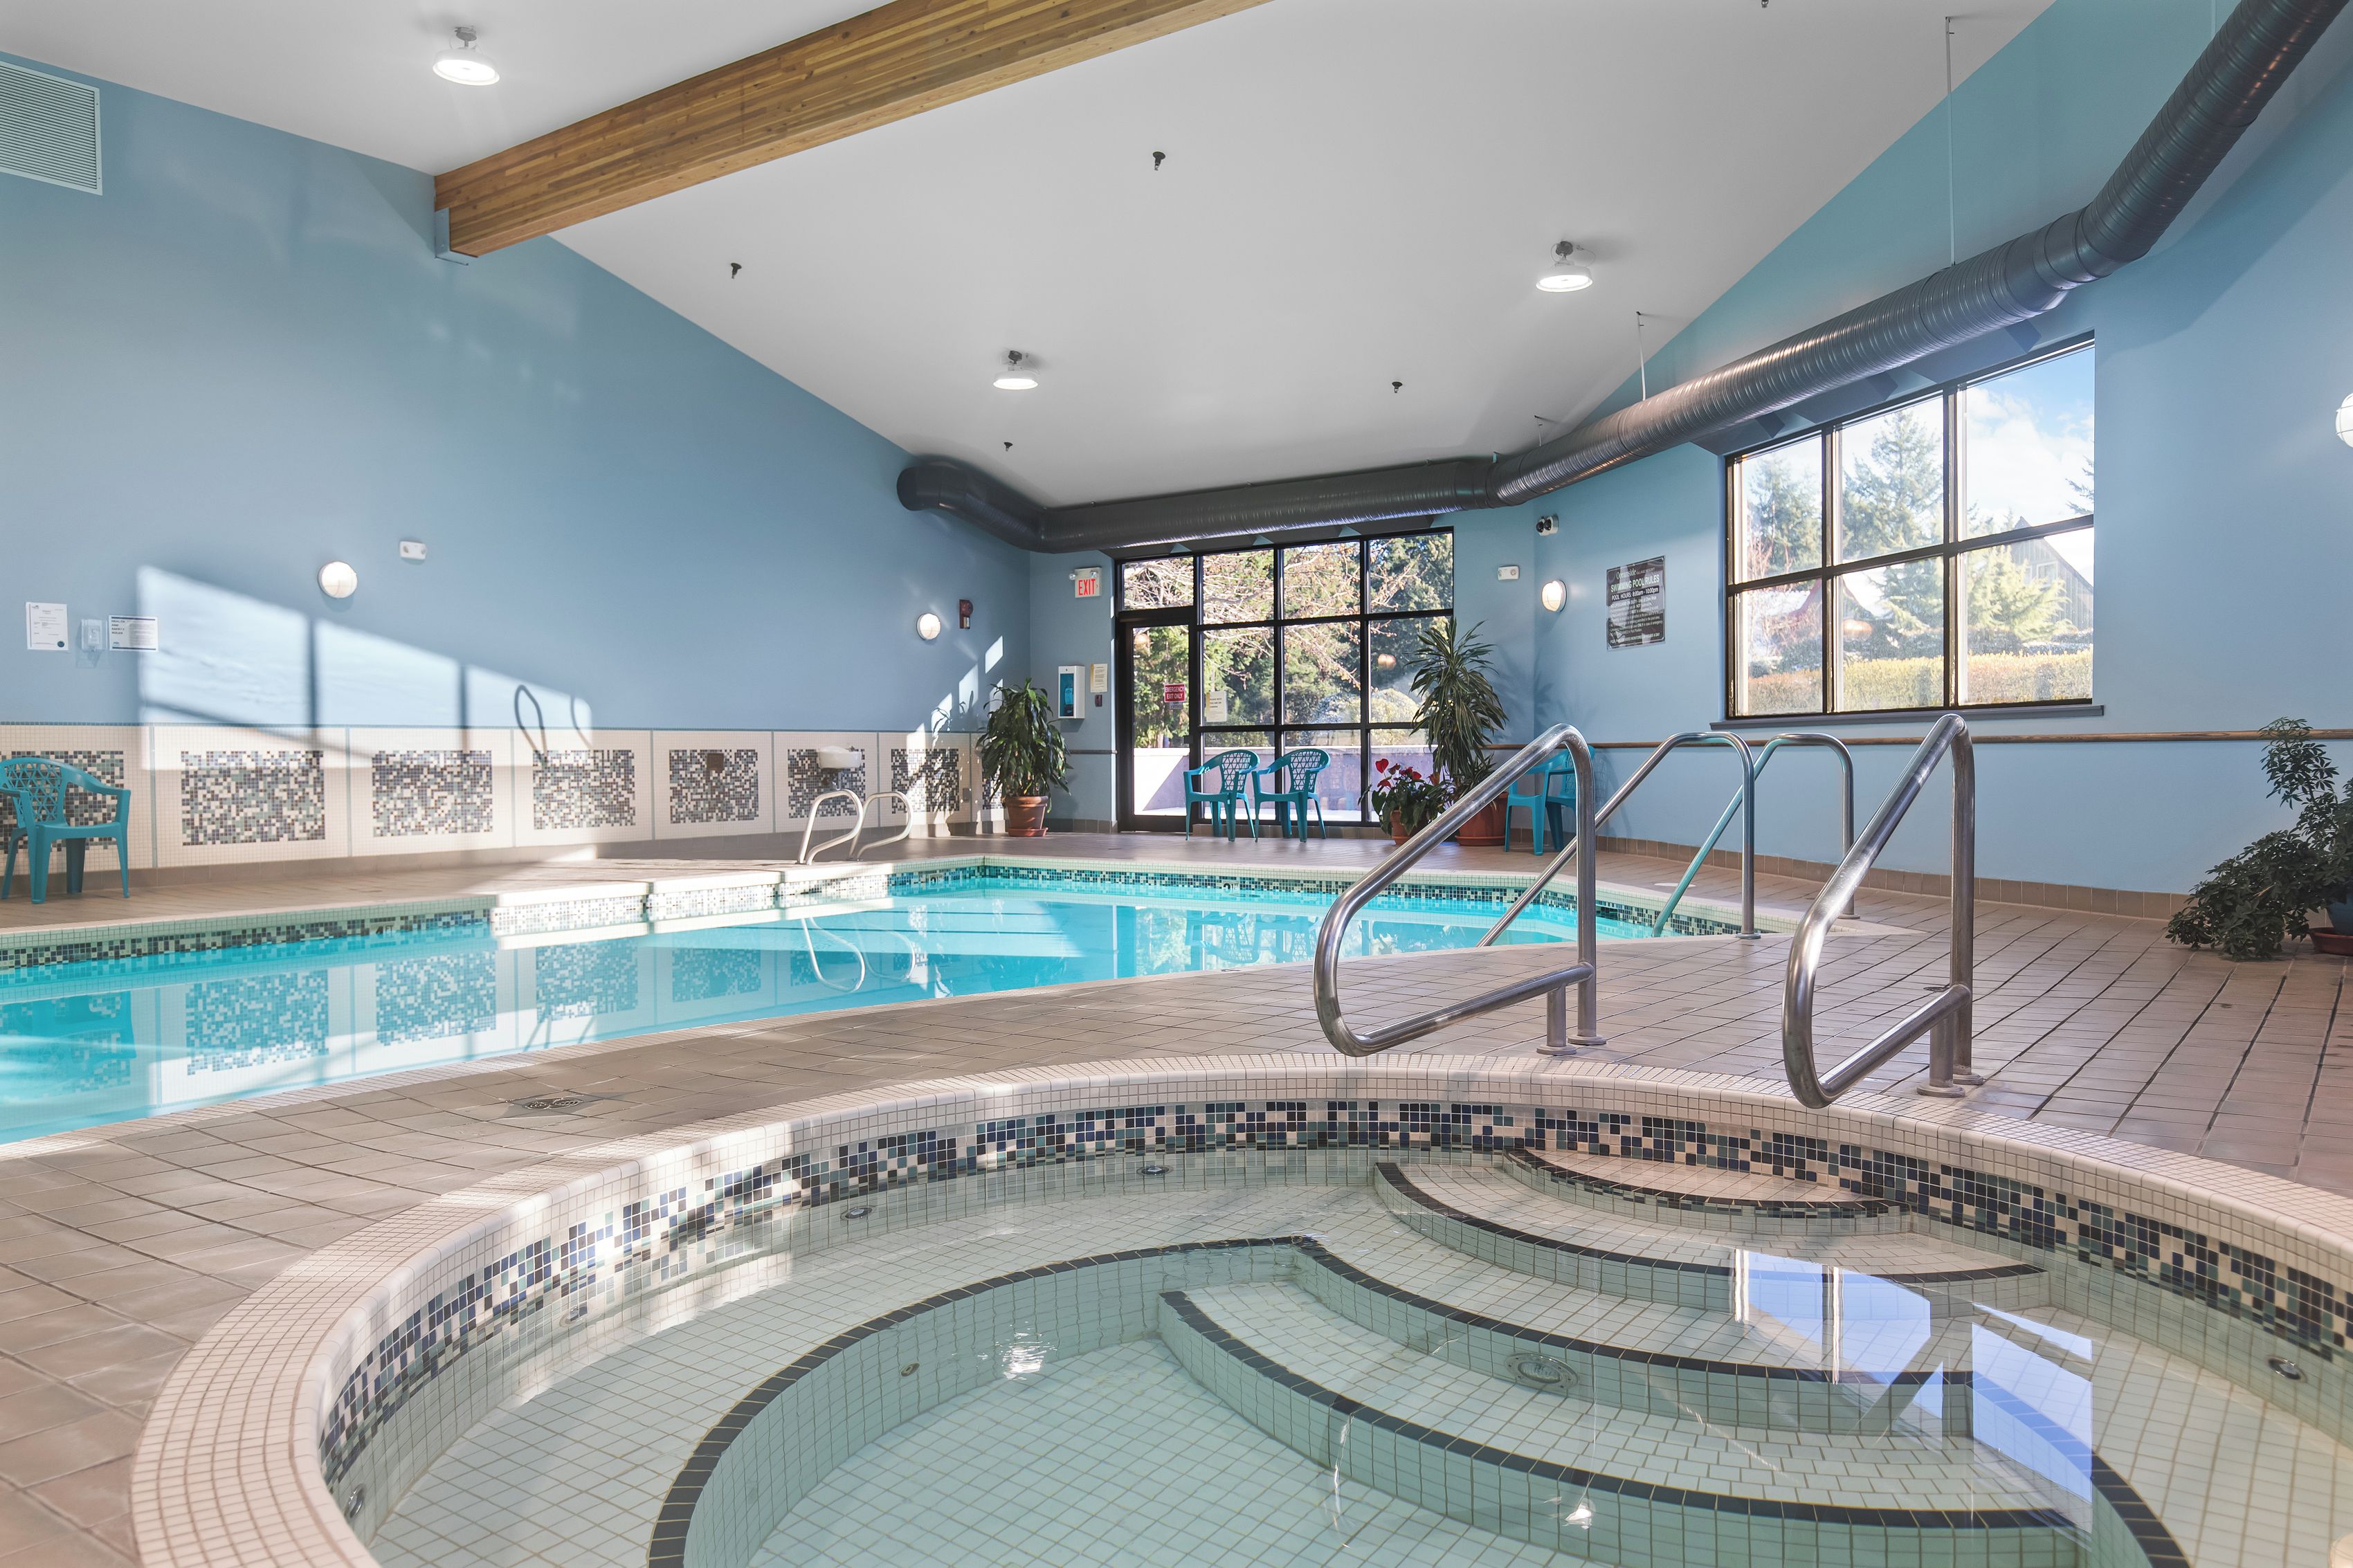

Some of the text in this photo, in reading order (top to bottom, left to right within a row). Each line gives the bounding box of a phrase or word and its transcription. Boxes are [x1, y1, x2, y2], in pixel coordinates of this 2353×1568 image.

[1078, 578, 1096, 596] EXIT
[1610, 574, 1660, 592] SWIMMING POOL RULES
